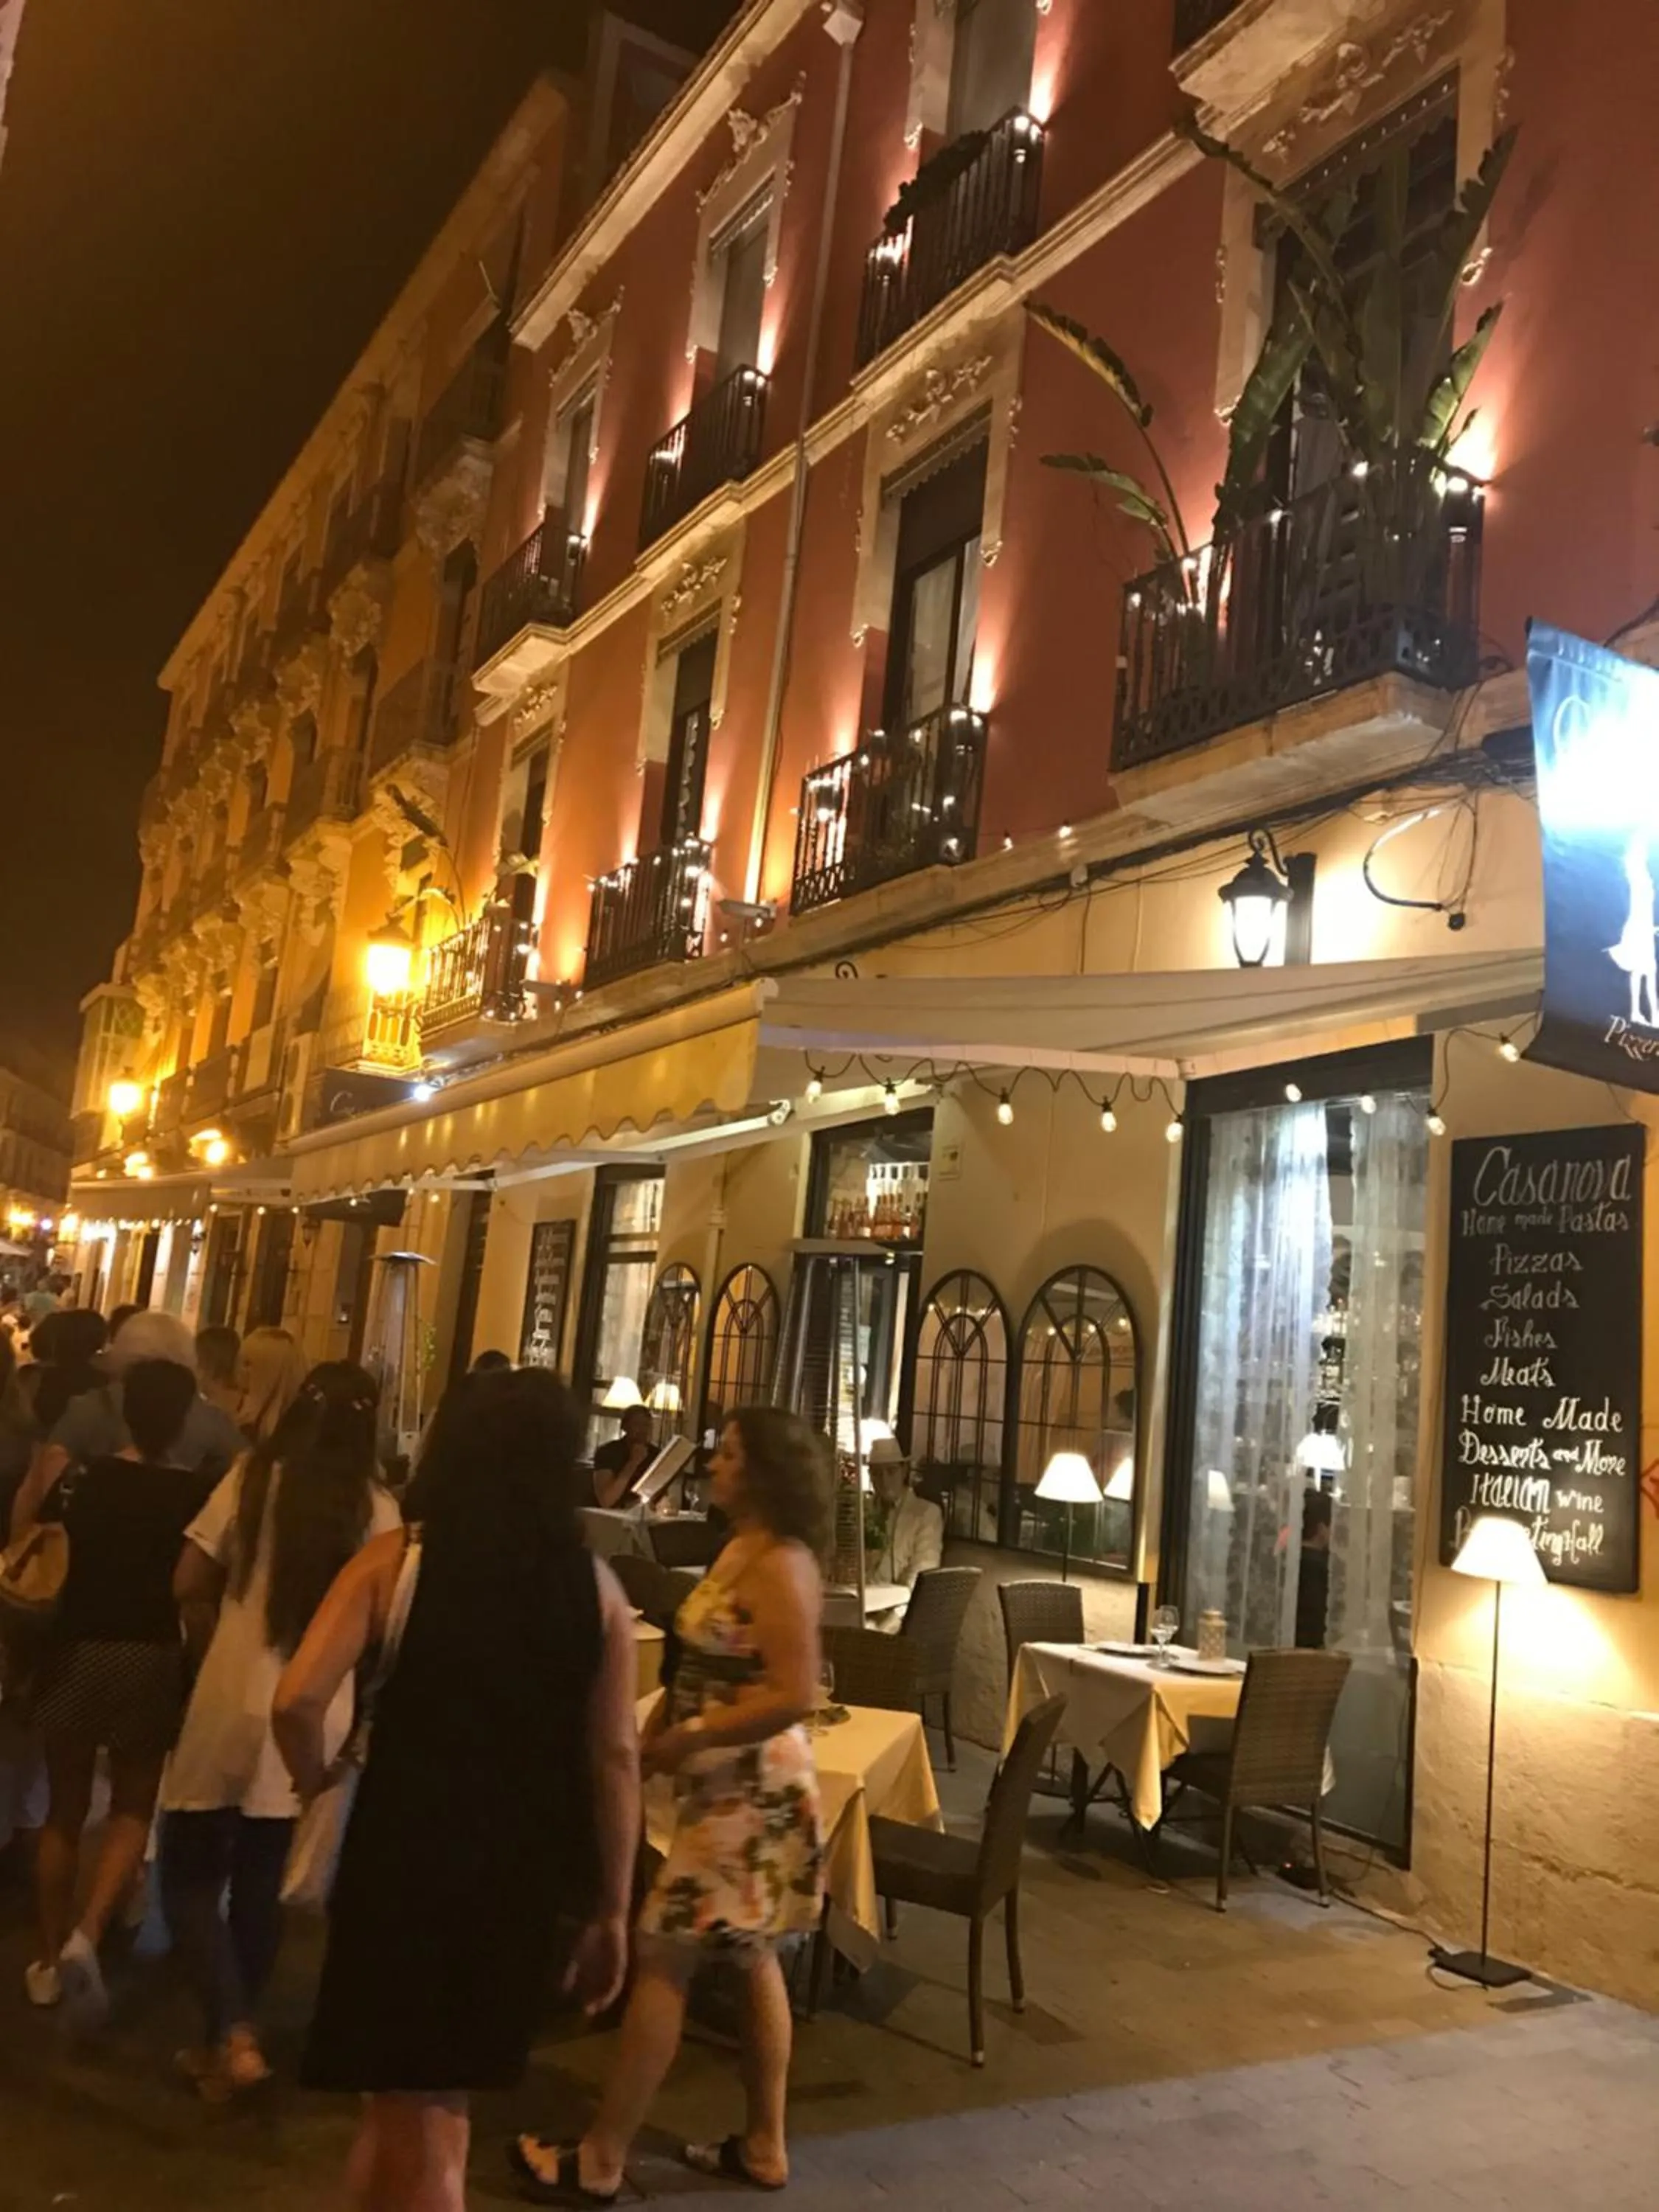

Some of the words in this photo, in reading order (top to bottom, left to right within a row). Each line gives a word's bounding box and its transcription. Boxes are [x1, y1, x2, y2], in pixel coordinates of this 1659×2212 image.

[1474, 1147, 1632, 1206] Casanova
[1559, 1201, 1629, 1233] Pastas
[1489, 1243, 1584, 1275] Pizzas
[1479, 1281, 1579, 1310] Salads
[1484, 1316, 1558, 1349] Fishes
[1480, 1356, 1556, 1387] Meats
[1461, 1394, 1526, 1427] Home
[1543, 1397, 1624, 1433] Made
[1458, 1429, 1551, 1470] Desserts
[1575, 1439, 1626, 1476] More
